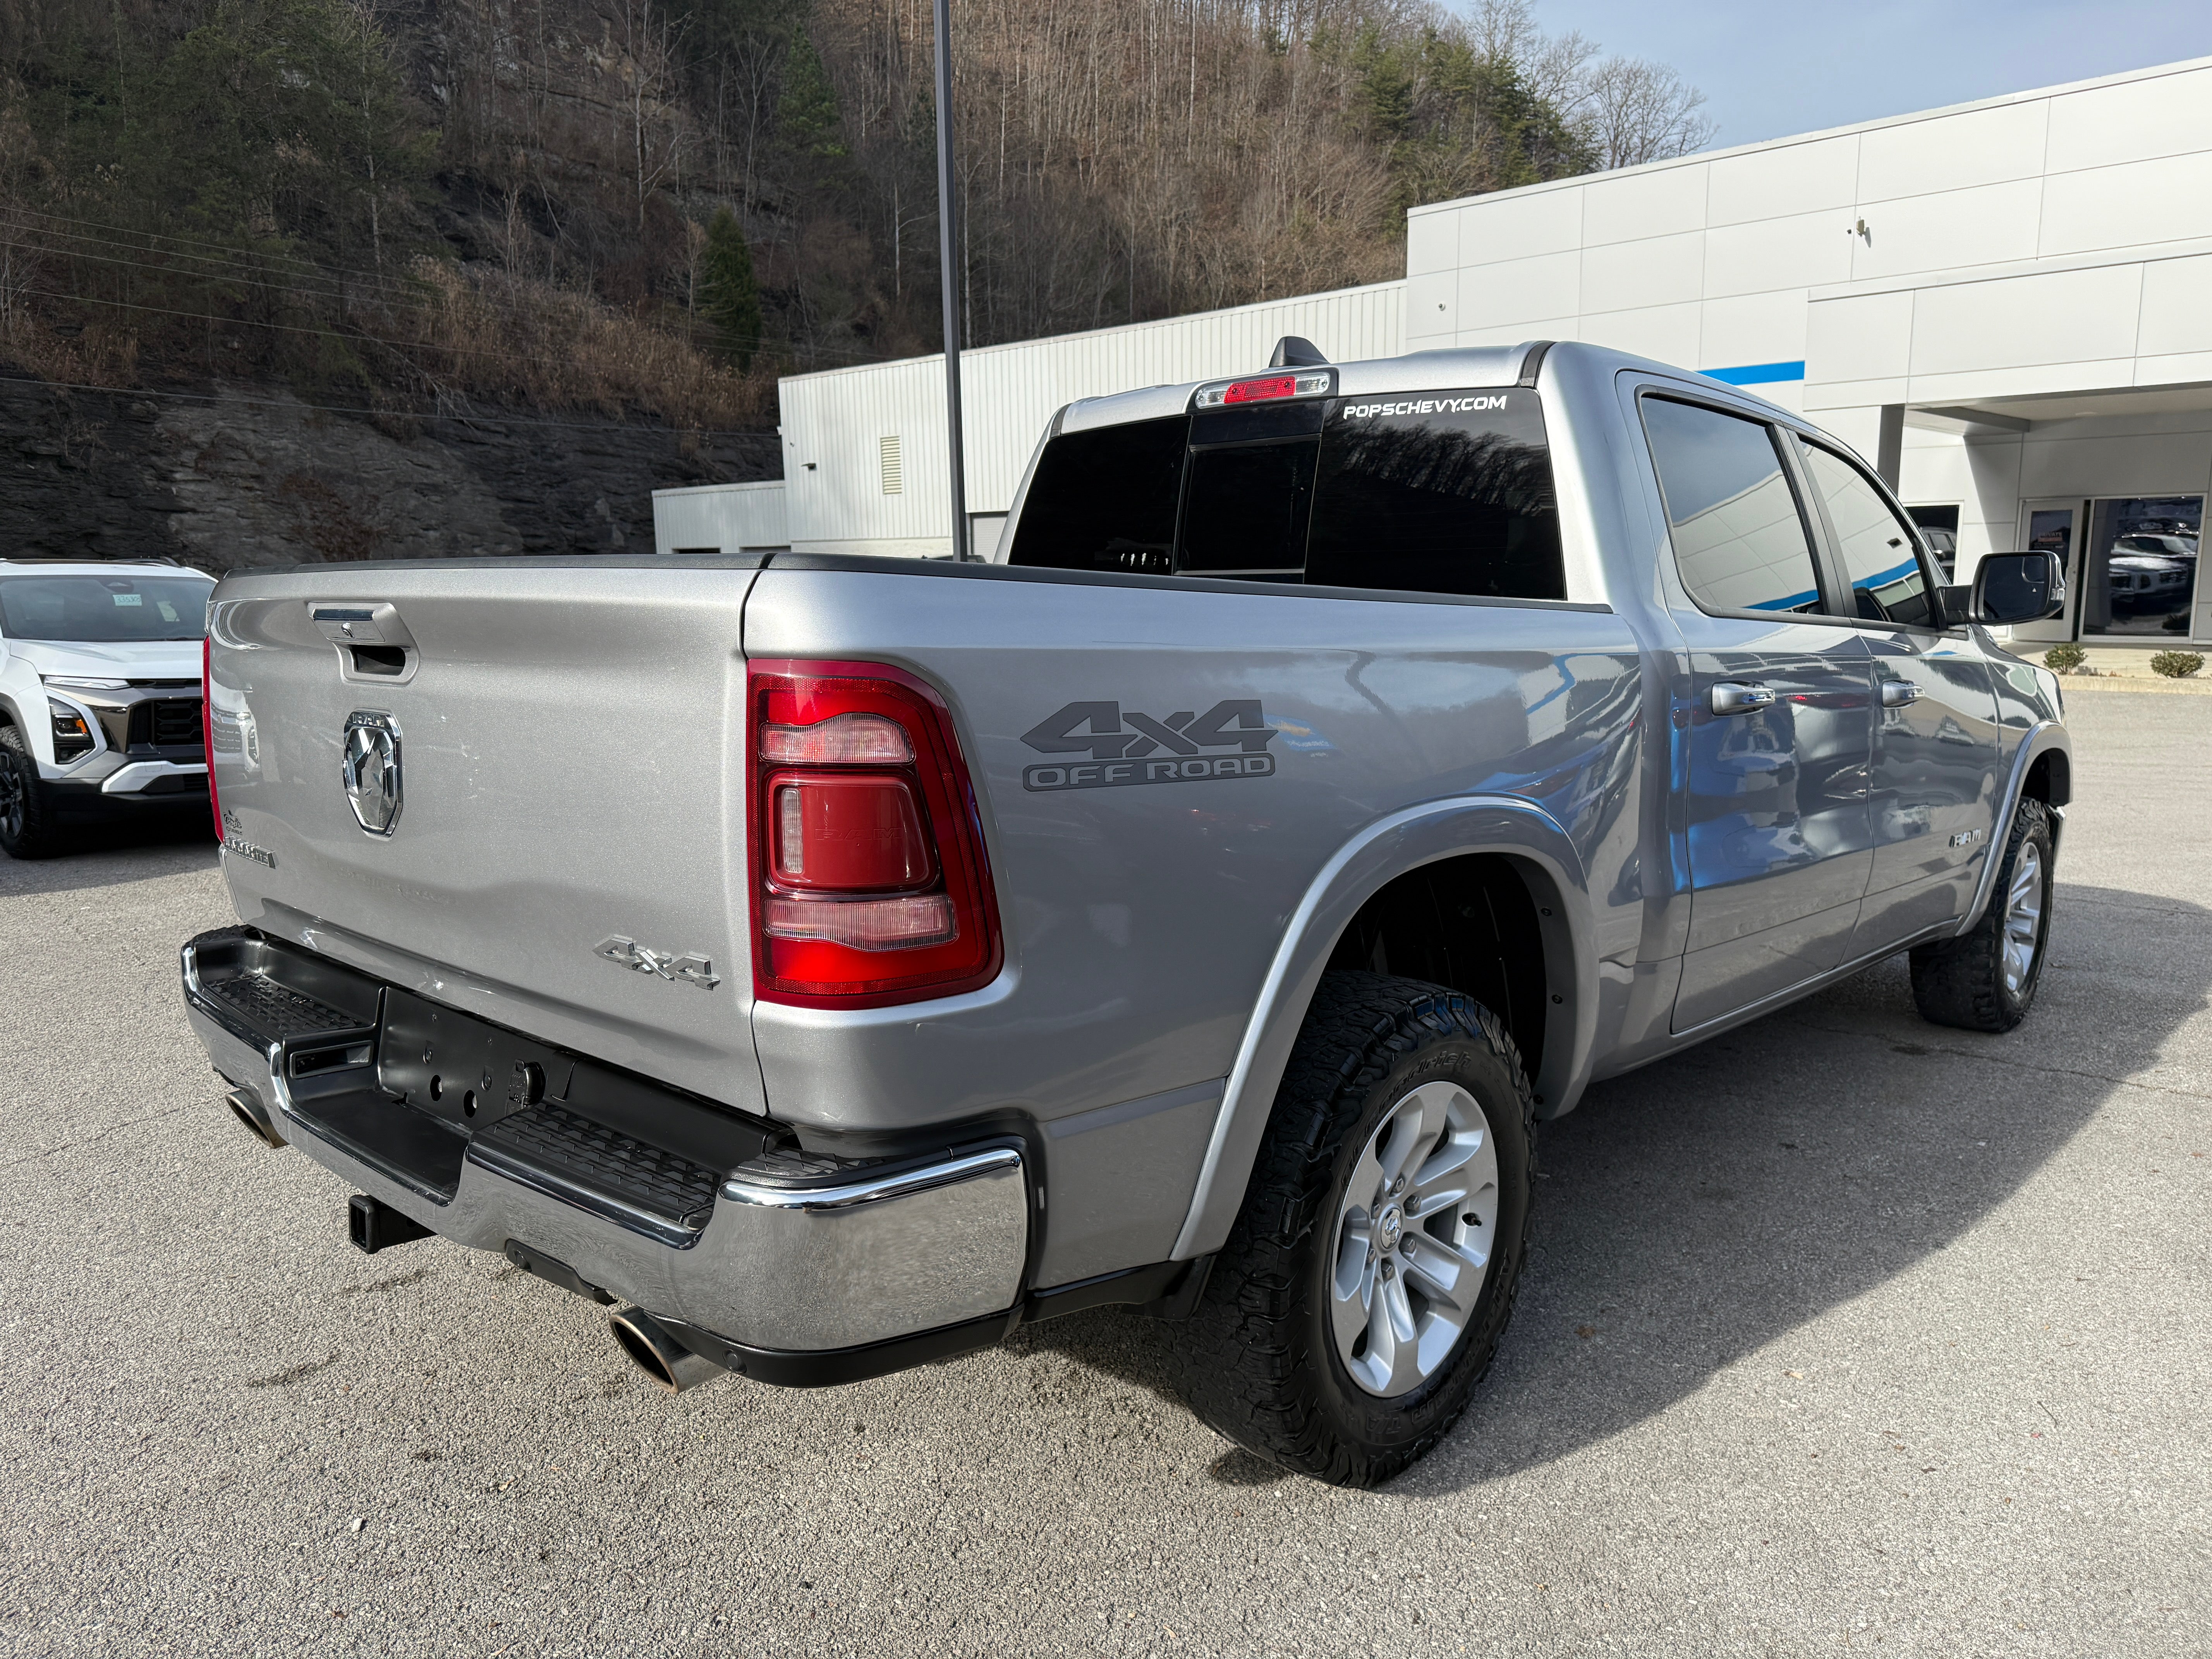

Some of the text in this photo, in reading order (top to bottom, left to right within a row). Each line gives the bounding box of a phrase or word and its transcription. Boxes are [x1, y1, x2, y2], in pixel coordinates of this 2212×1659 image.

[1343, 395, 1507, 420] POPSCHEVY.COM
[1029, 757, 1272, 788] OFF ROAD
[814, 827, 902, 841] RAM
[1949, 828, 1981, 848] RAM
